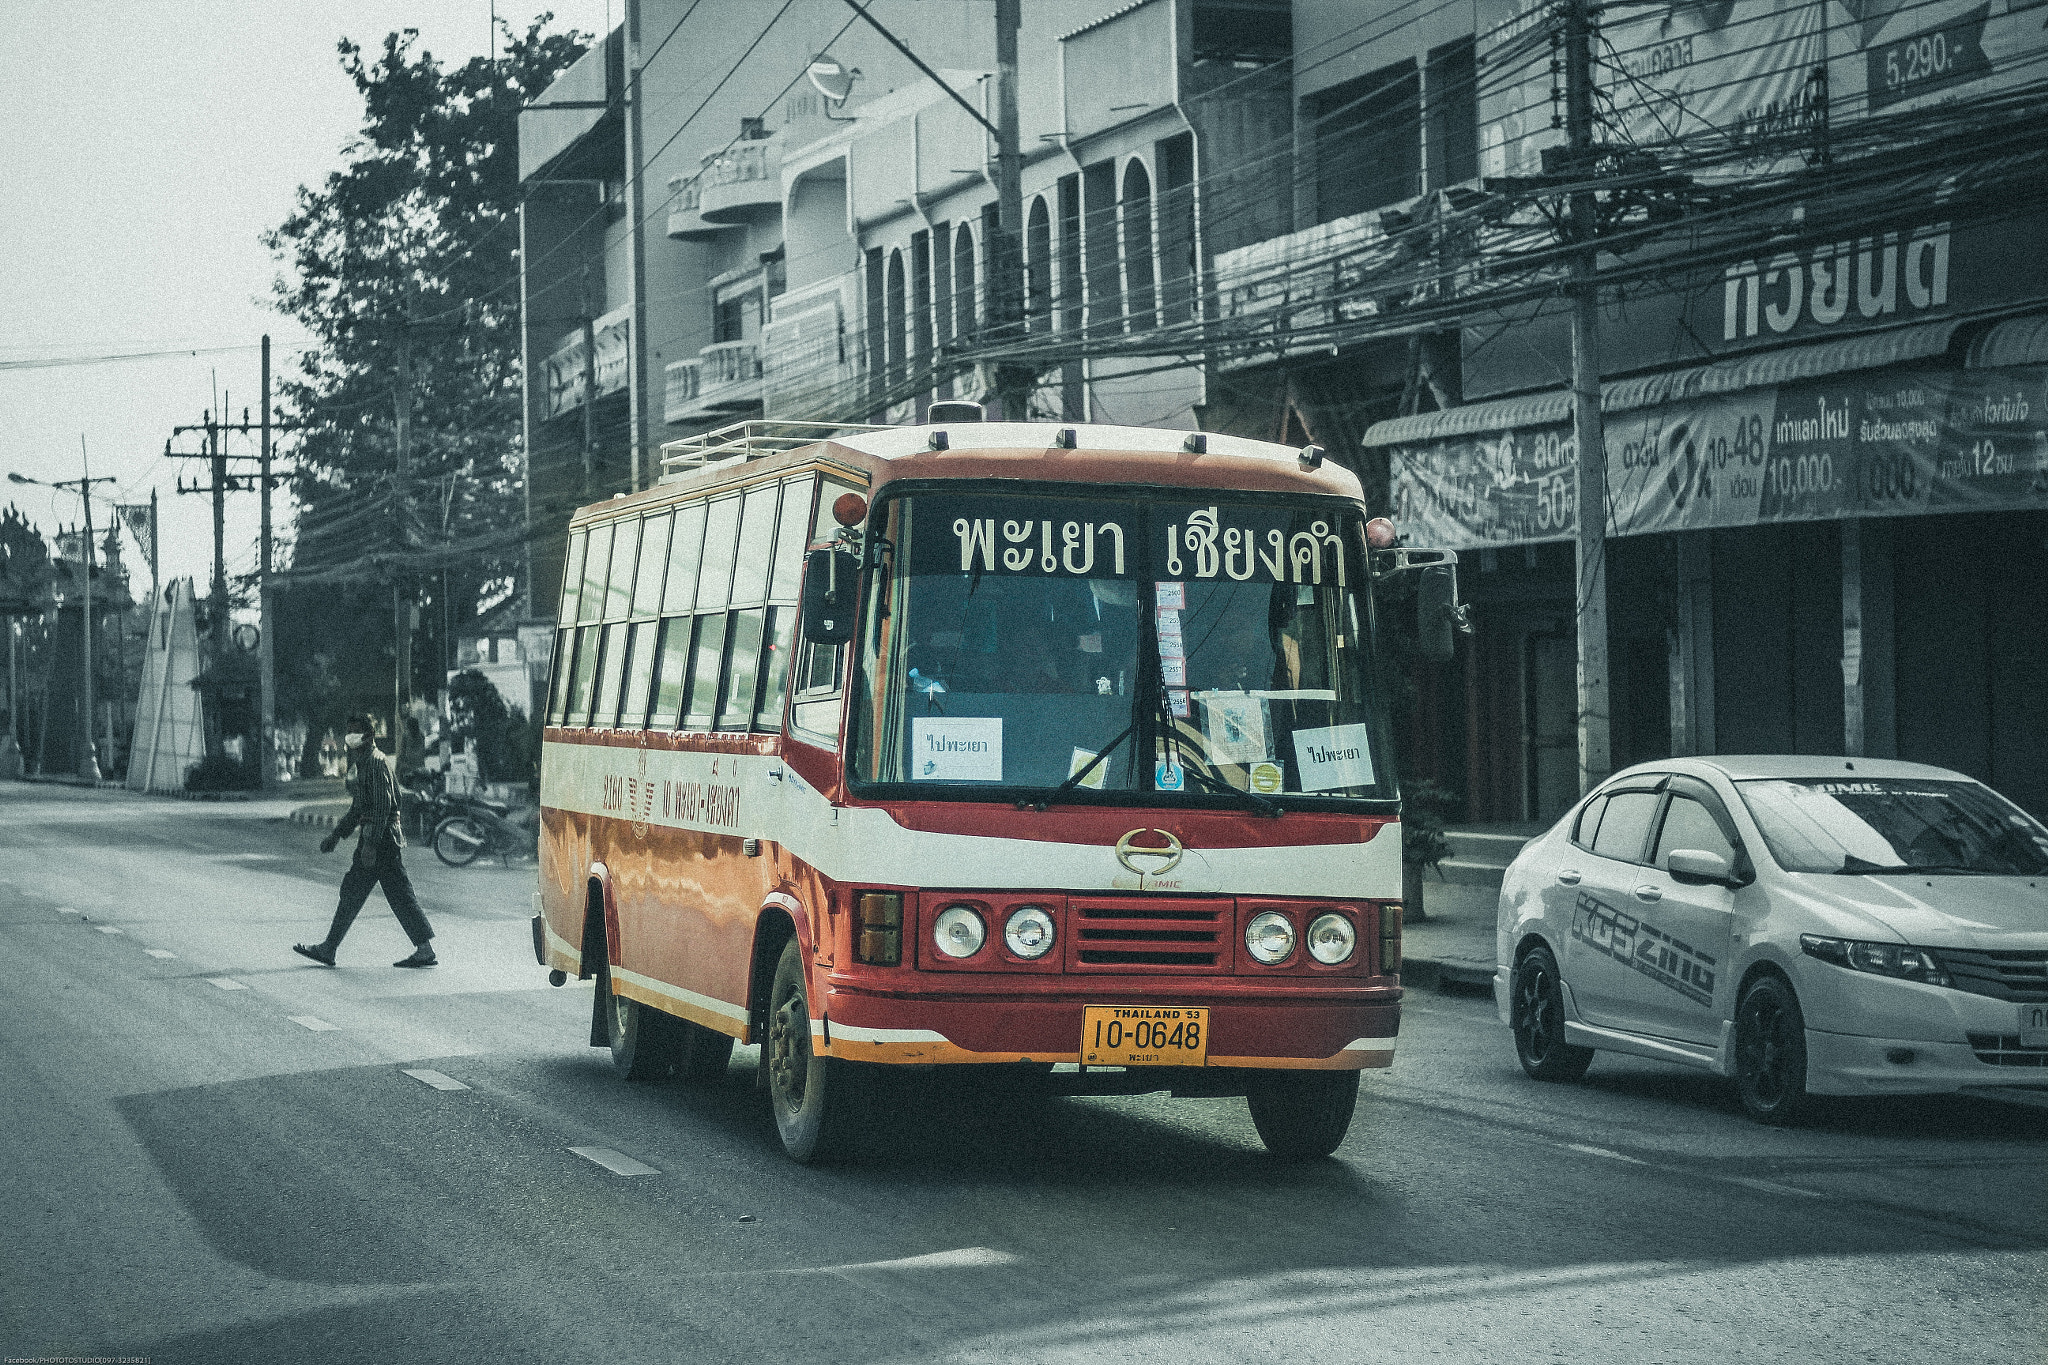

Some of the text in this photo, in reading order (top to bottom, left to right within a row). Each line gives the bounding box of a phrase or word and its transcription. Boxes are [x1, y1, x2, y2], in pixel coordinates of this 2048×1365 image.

[1775, 394, 1850, 444] เก่าแลกใหม่
[1709, 412, 1764, 470] 10-48
[1971, 439, 1995, 476] 12
[1768, 452, 1843, 503] 10,000.-
[953, 506, 1346, 587] พะเยา เชียงคำ
[926, 733, 989, 753] ไปพะเยา
[1306, 744, 1361, 764] ไปพะเยา
[1113, 1009, 1181, 1019] THAILAND
[1095, 1020, 1201, 1049] 10-0648
[1128, 1053, 1160, 1062] พะเยา
